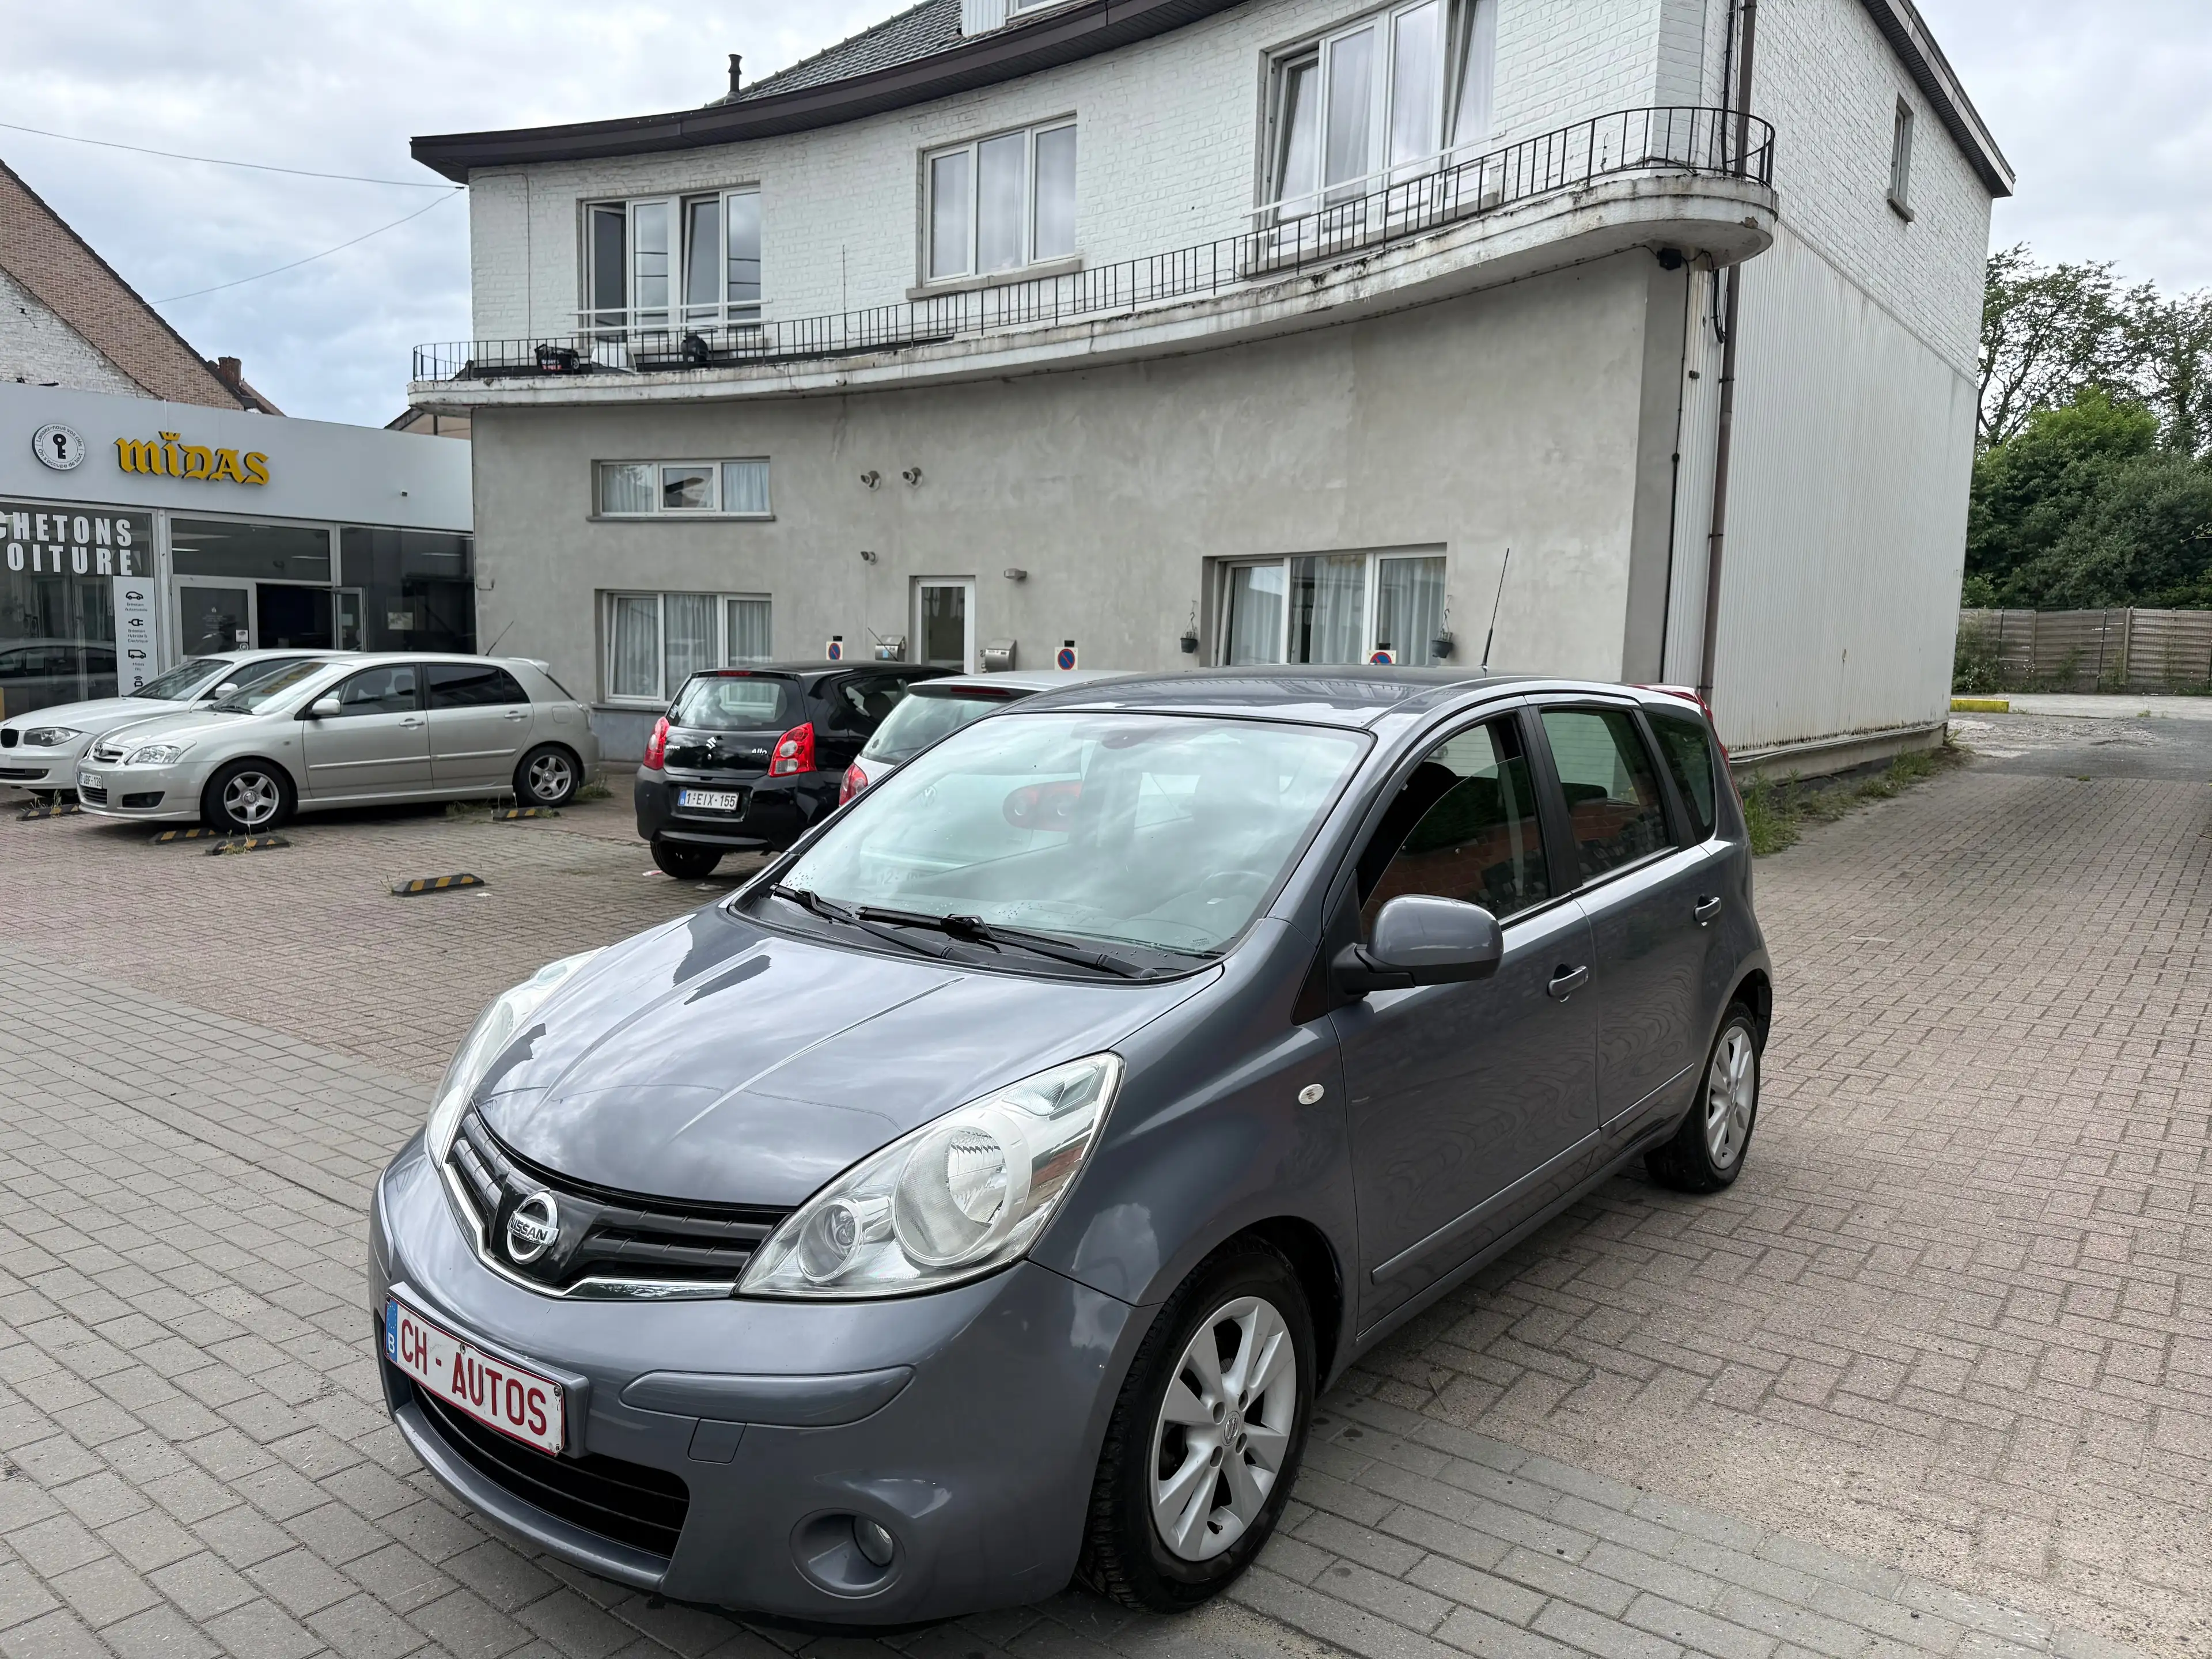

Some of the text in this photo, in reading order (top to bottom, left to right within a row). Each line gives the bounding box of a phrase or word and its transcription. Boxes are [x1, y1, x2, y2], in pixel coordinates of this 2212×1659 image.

[38, 449, 44, 457] On
[7, 543, 132, 576] OITURE
[509, 1217, 548, 1241] NISSAN
[388, 1332, 395, 1354] B
